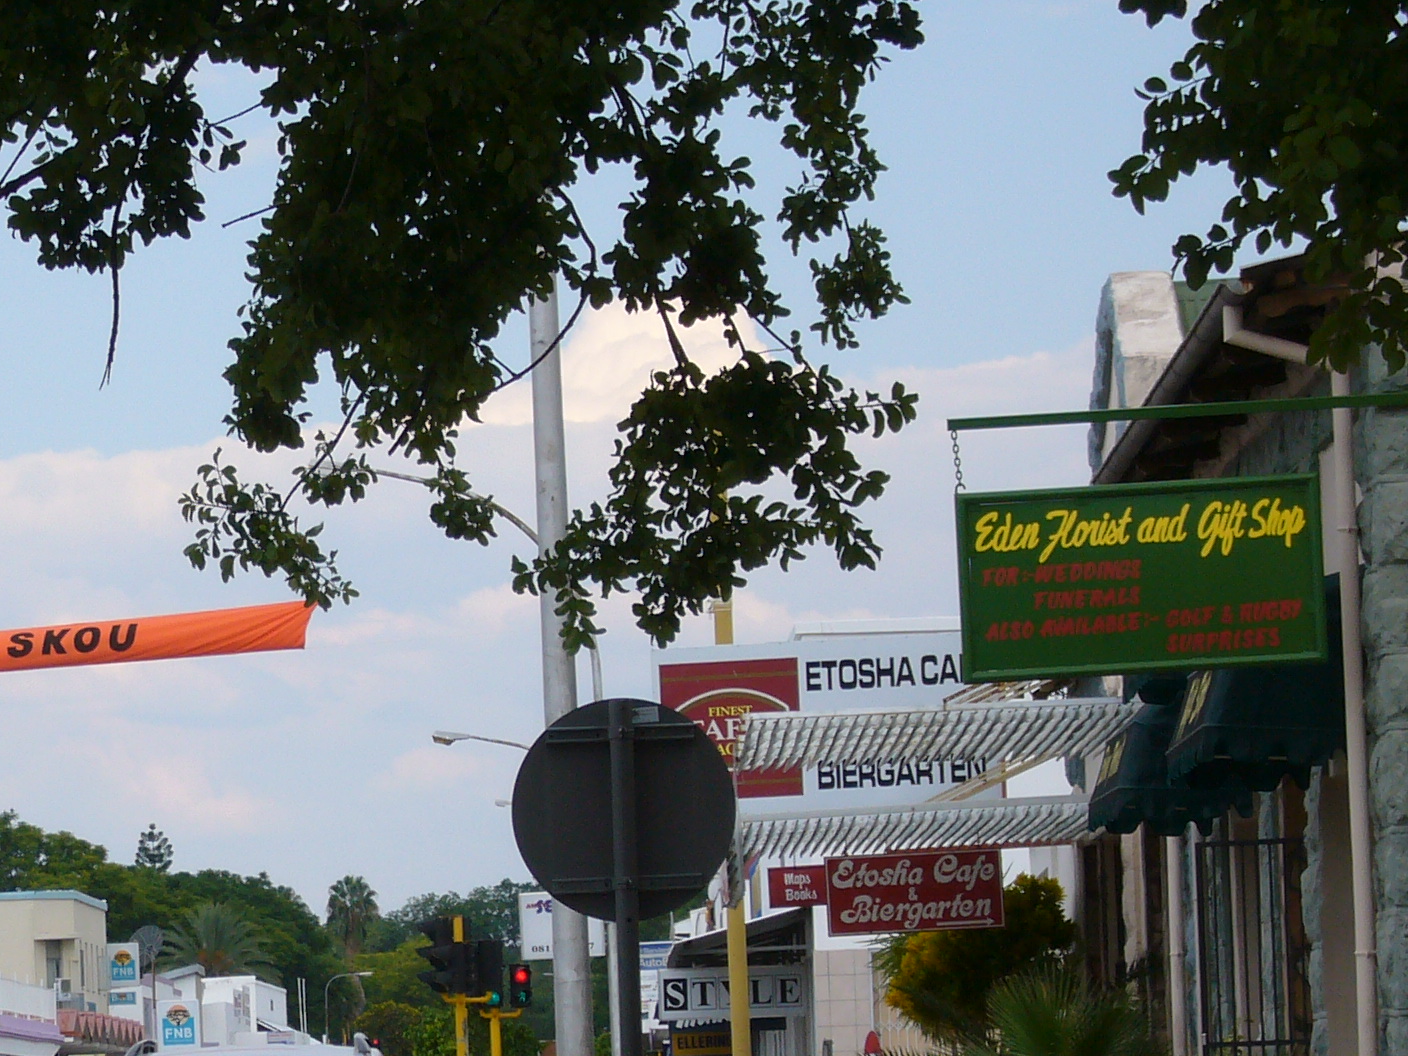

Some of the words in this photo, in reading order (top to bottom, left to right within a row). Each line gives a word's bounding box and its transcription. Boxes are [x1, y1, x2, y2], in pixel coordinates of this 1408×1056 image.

[974, 511, 1040, 552] Eden
[1038, 506, 1132, 563] Florist
[1137, 503, 1191, 543] and
[1197, 500, 1248, 557] Gift
[1248, 498, 1306, 547] Shop
[1033, 586, 1141, 610] FUNERALS
[985, 620, 1034, 641] ALSO
[1165, 605, 1214, 628] GOLF
[1239, 598, 1303, 623] RUGBY
[7, 623, 138, 658] SKOU
[1165, 627, 1281, 653] SURPRISES
[805, 656, 917, 692] ETOSHA
[708, 705, 753, 718] FINEST
[817, 755, 988, 791] BIERGARTEN
[784, 872, 812, 893] Maps
[831, 859, 924, 890] Etosha
[933, 853, 996, 892] Cafe
[785, 888, 818, 902] Books
[907, 886, 918, 902] &
[840, 893, 992, 930] Biergarten
[112, 967, 134, 976] FNB
[165, 1026, 193, 1040] FNB
